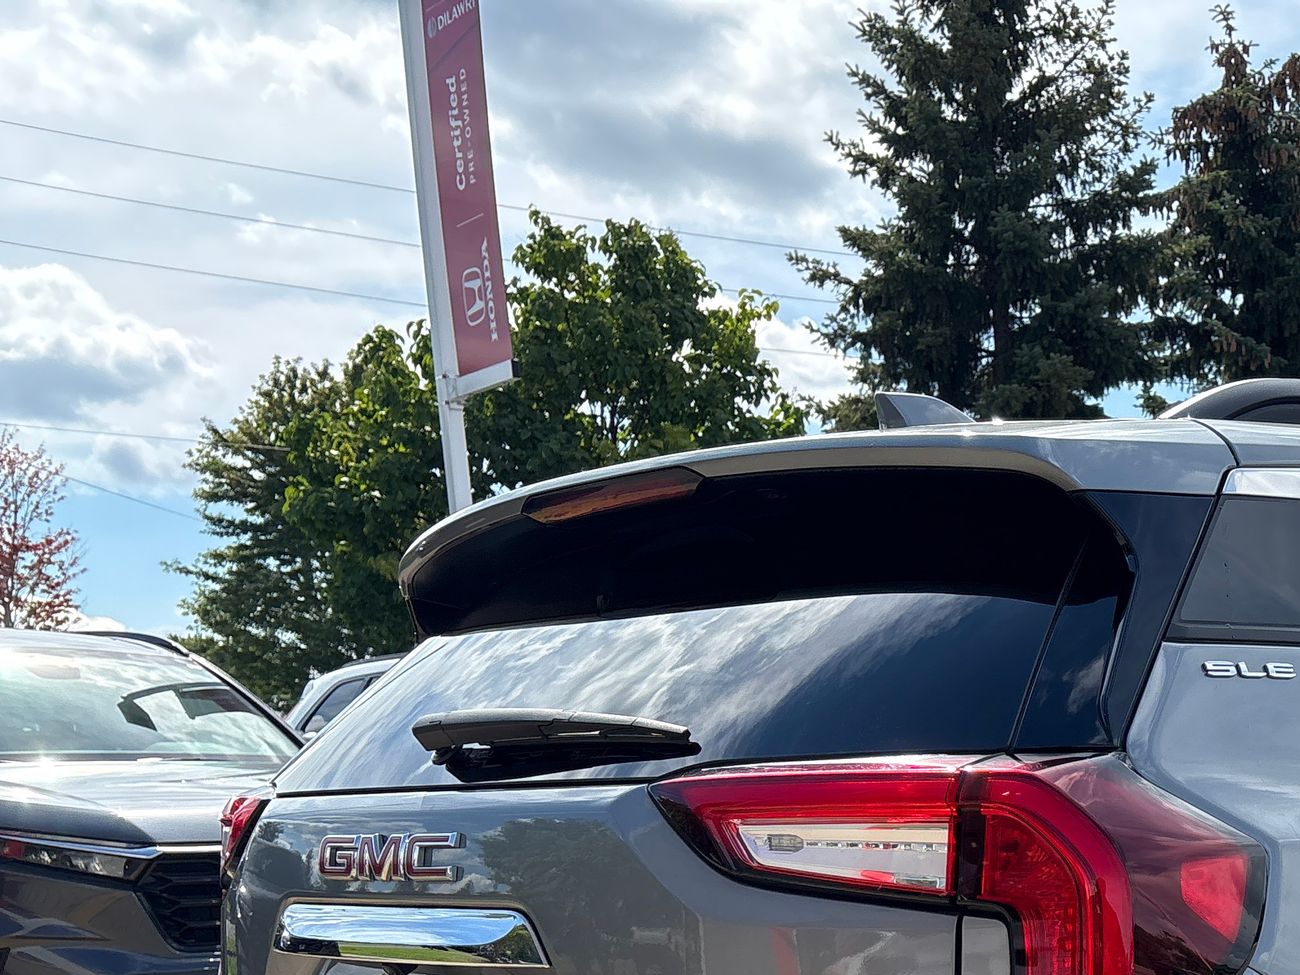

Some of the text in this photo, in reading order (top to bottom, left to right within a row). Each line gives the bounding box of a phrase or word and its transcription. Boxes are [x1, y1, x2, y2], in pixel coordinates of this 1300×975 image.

[437, 0, 475, 31] DILAWRI
[445, 75, 465, 191] Certified
[459, 67, 477, 184] PRE-OWNED
[481, 236, 498, 342] HONDA
[1201, 660, 1297, 680] SLE
[318, 831, 468, 883] GMC
